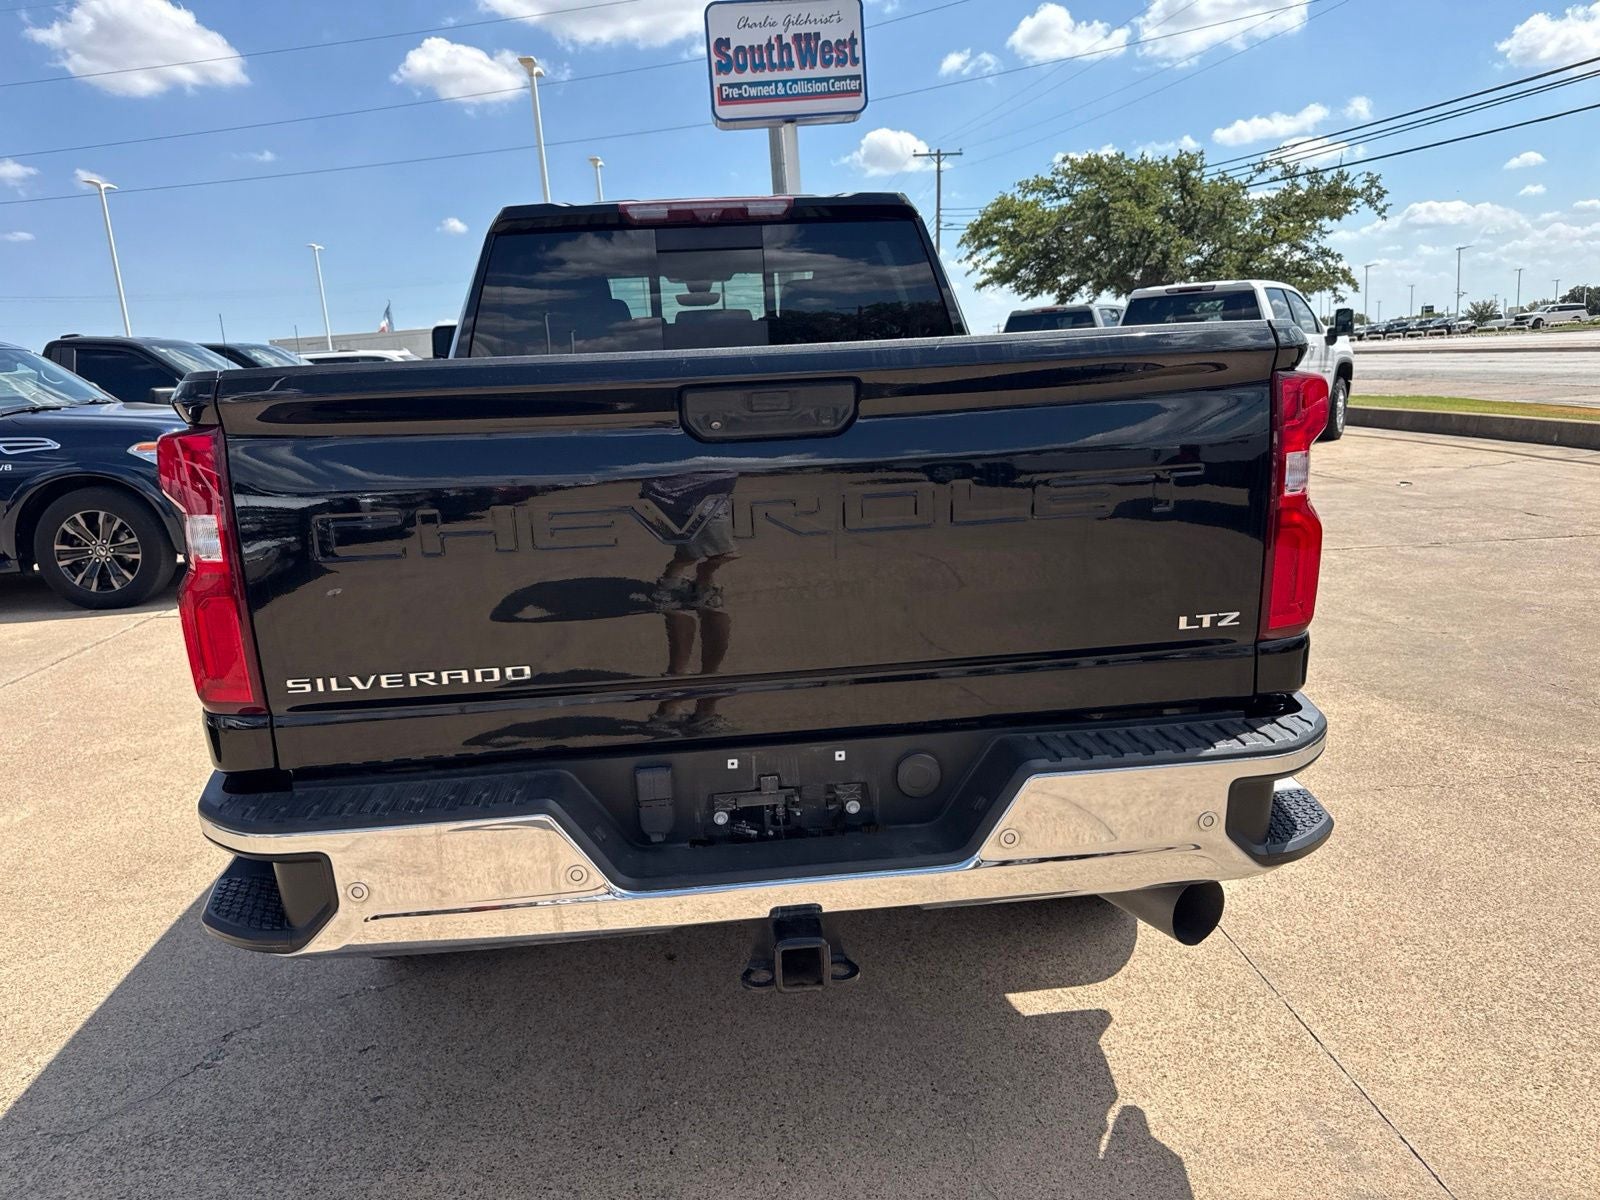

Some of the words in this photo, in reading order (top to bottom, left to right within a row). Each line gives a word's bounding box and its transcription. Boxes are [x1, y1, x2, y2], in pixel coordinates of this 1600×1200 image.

[736, 15, 778, 30] Charlie
[782, 11, 843, 33] Gilchrist's
[713, 30, 860, 76] SouthWest
[722, 83, 776, 99] Pre-Owned
[776, 83, 785, 95] &
[786, 79, 828, 94] Collision
[828, 78, 861, 92] Center
[311, 463, 1205, 563] CHEVROLET
[1178, 611, 1241, 630] LTZ
[285, 665, 532, 694] SILVERADO
